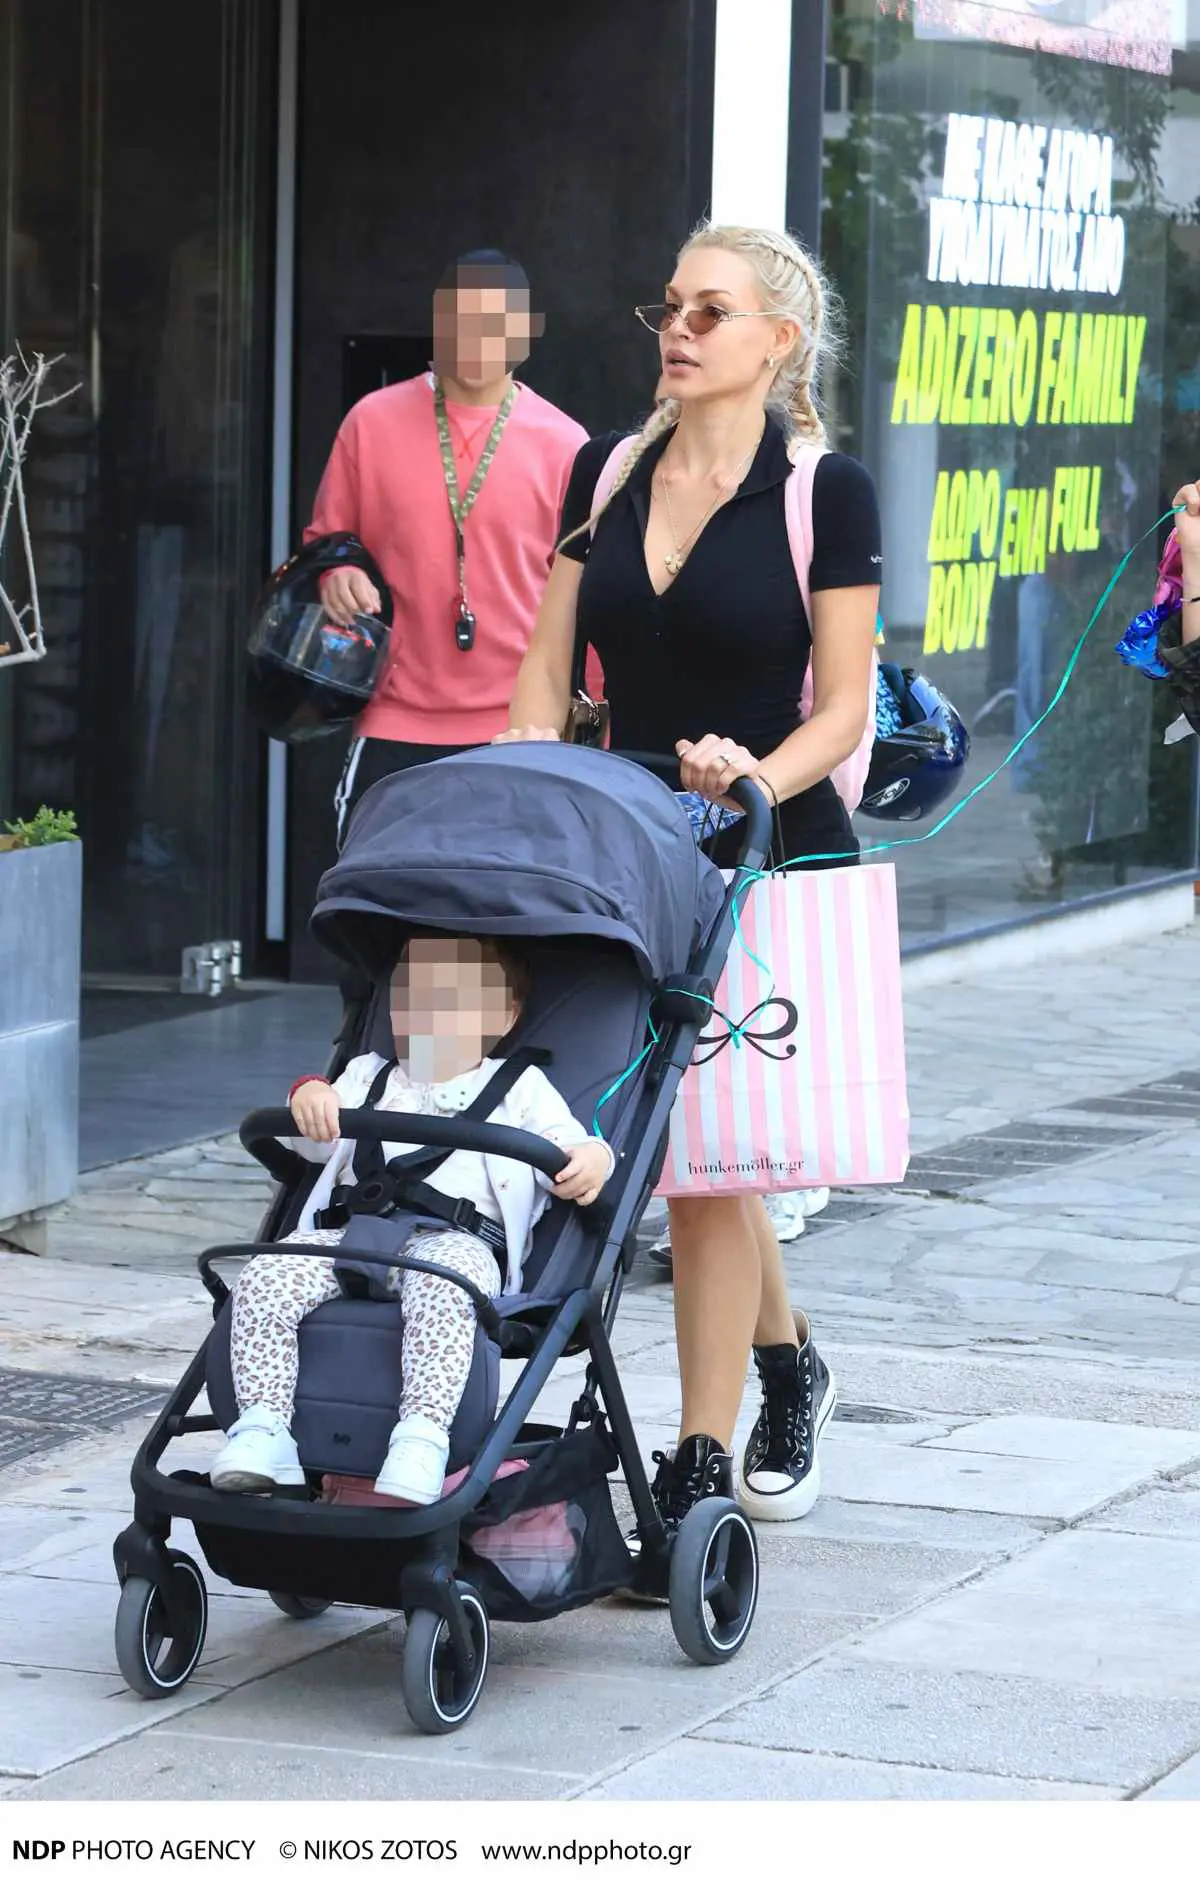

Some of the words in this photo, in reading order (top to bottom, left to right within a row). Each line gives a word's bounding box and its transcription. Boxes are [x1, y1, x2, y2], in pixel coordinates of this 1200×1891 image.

[891, 304, 1039, 426] ADIZERO
[1036, 311, 1147, 424] FAMILY
[1049, 466, 1101, 553] FULL
[923, 561, 996, 654] BODY
